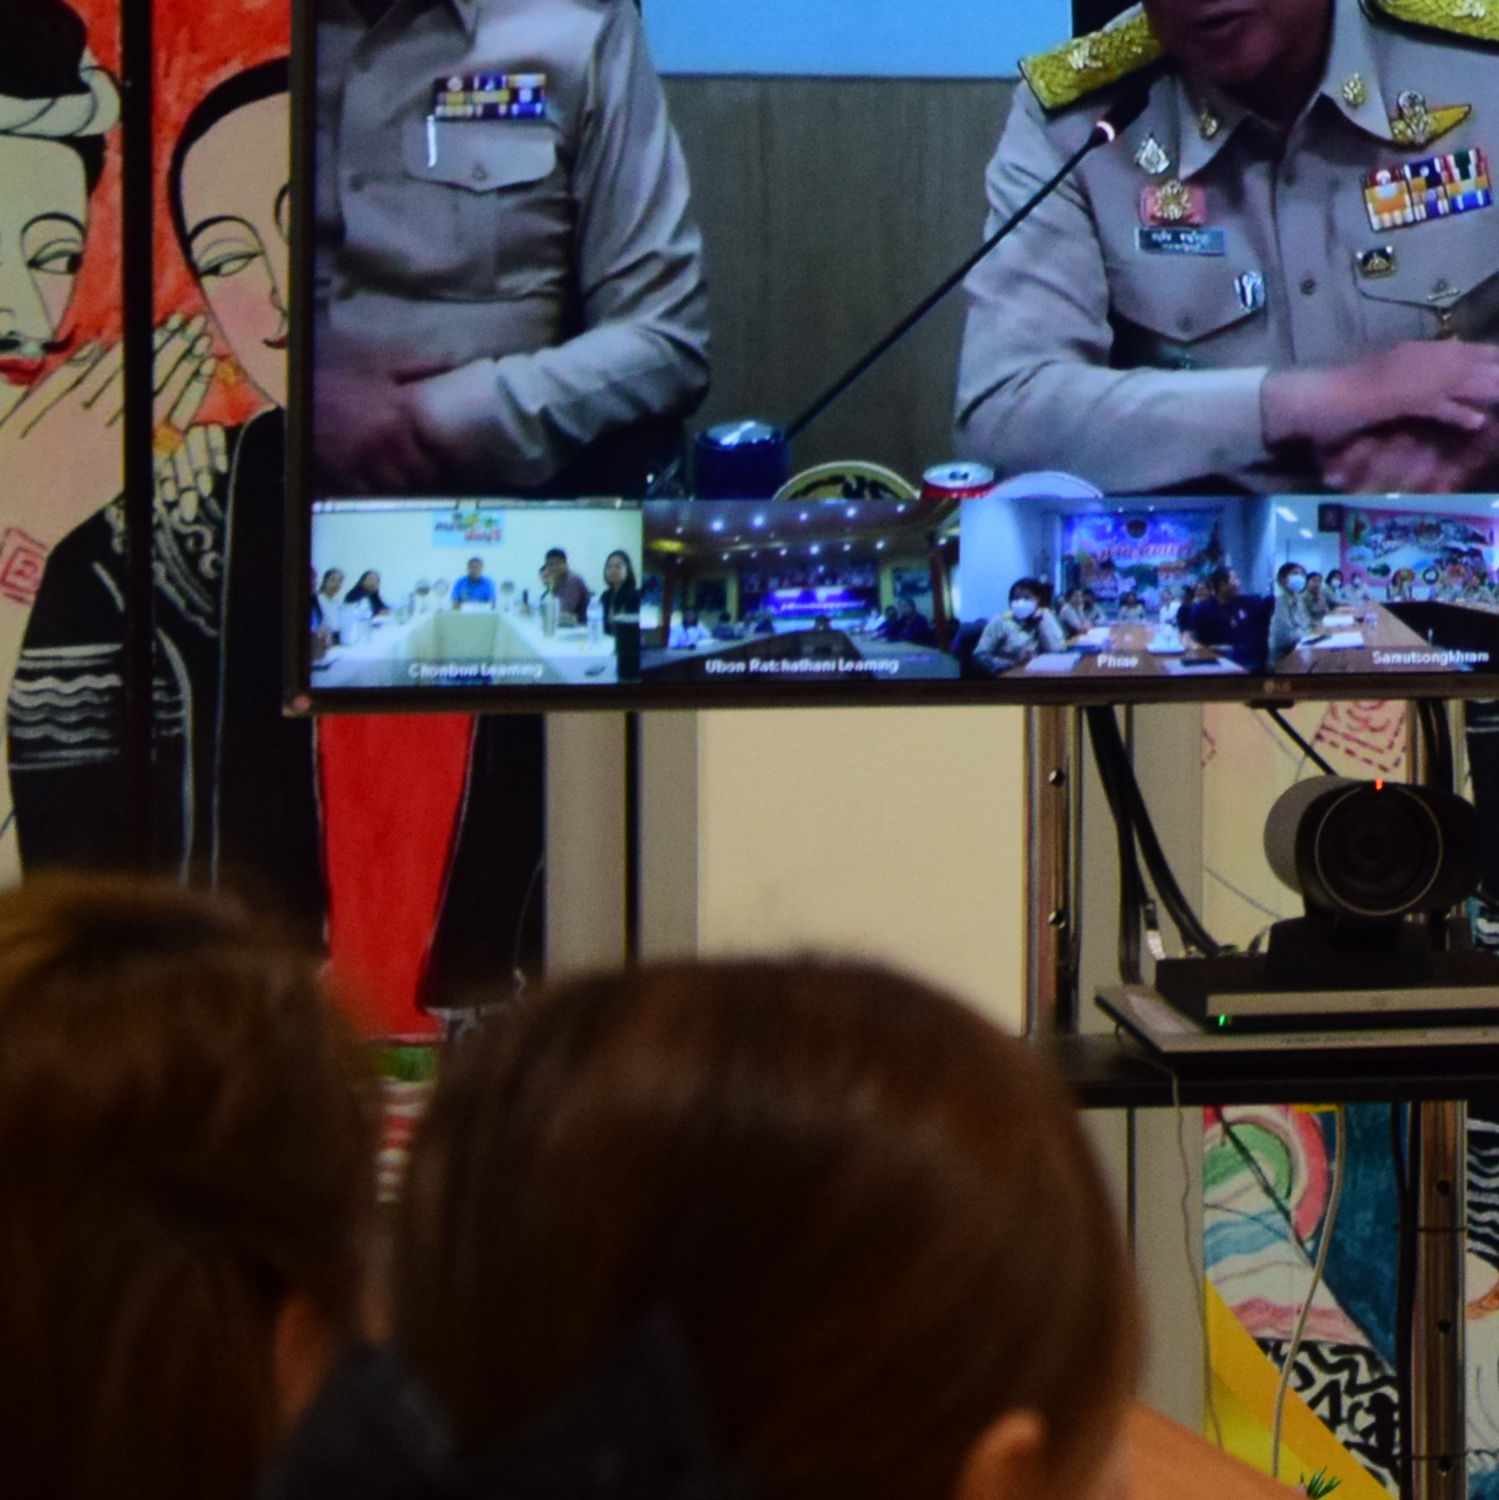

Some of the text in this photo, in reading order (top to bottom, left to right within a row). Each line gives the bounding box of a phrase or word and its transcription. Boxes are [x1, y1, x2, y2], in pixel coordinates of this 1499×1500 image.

[705, 659, 746, 674] Ubon
[749, 658, 836, 674] Ratchathani
[1097, 655, 1140, 669] Phrae
